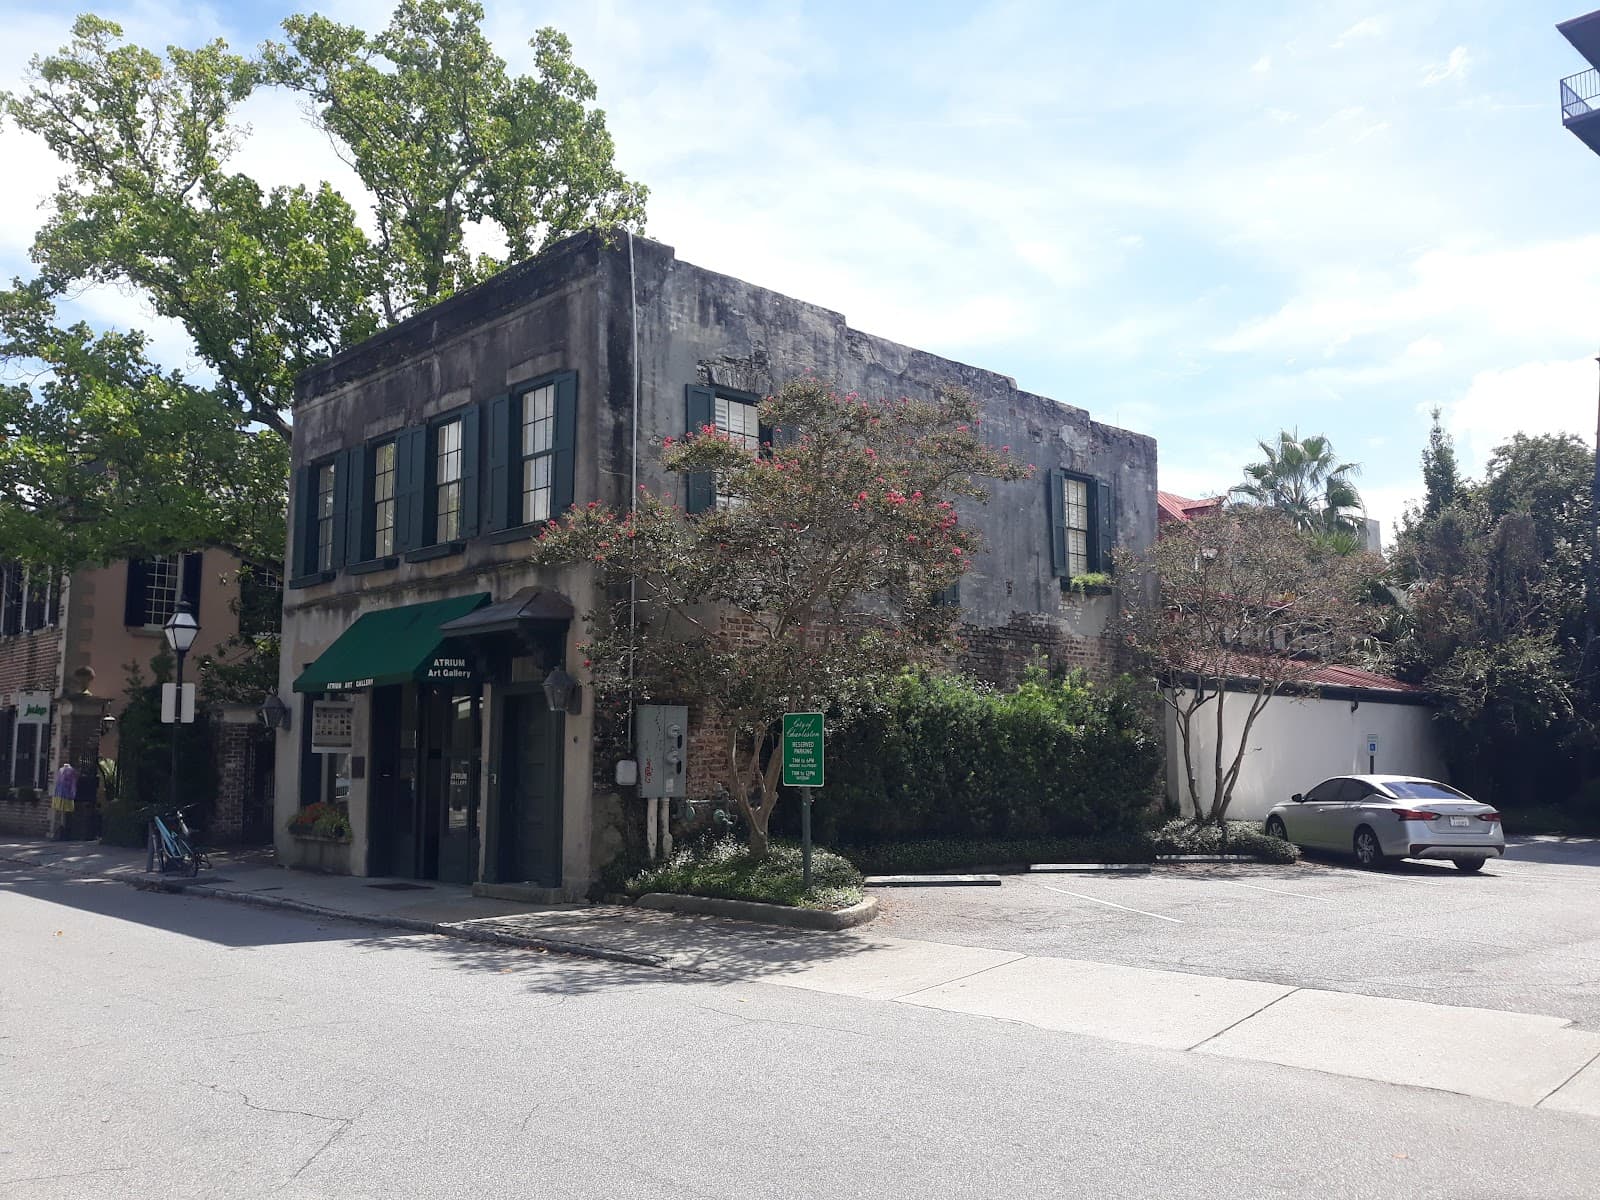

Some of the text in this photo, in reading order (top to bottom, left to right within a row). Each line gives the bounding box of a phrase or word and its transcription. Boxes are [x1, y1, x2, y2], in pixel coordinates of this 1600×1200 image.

[428, 669, 471, 679] Art Gallery
[786, 727, 820, 738] Charleston
